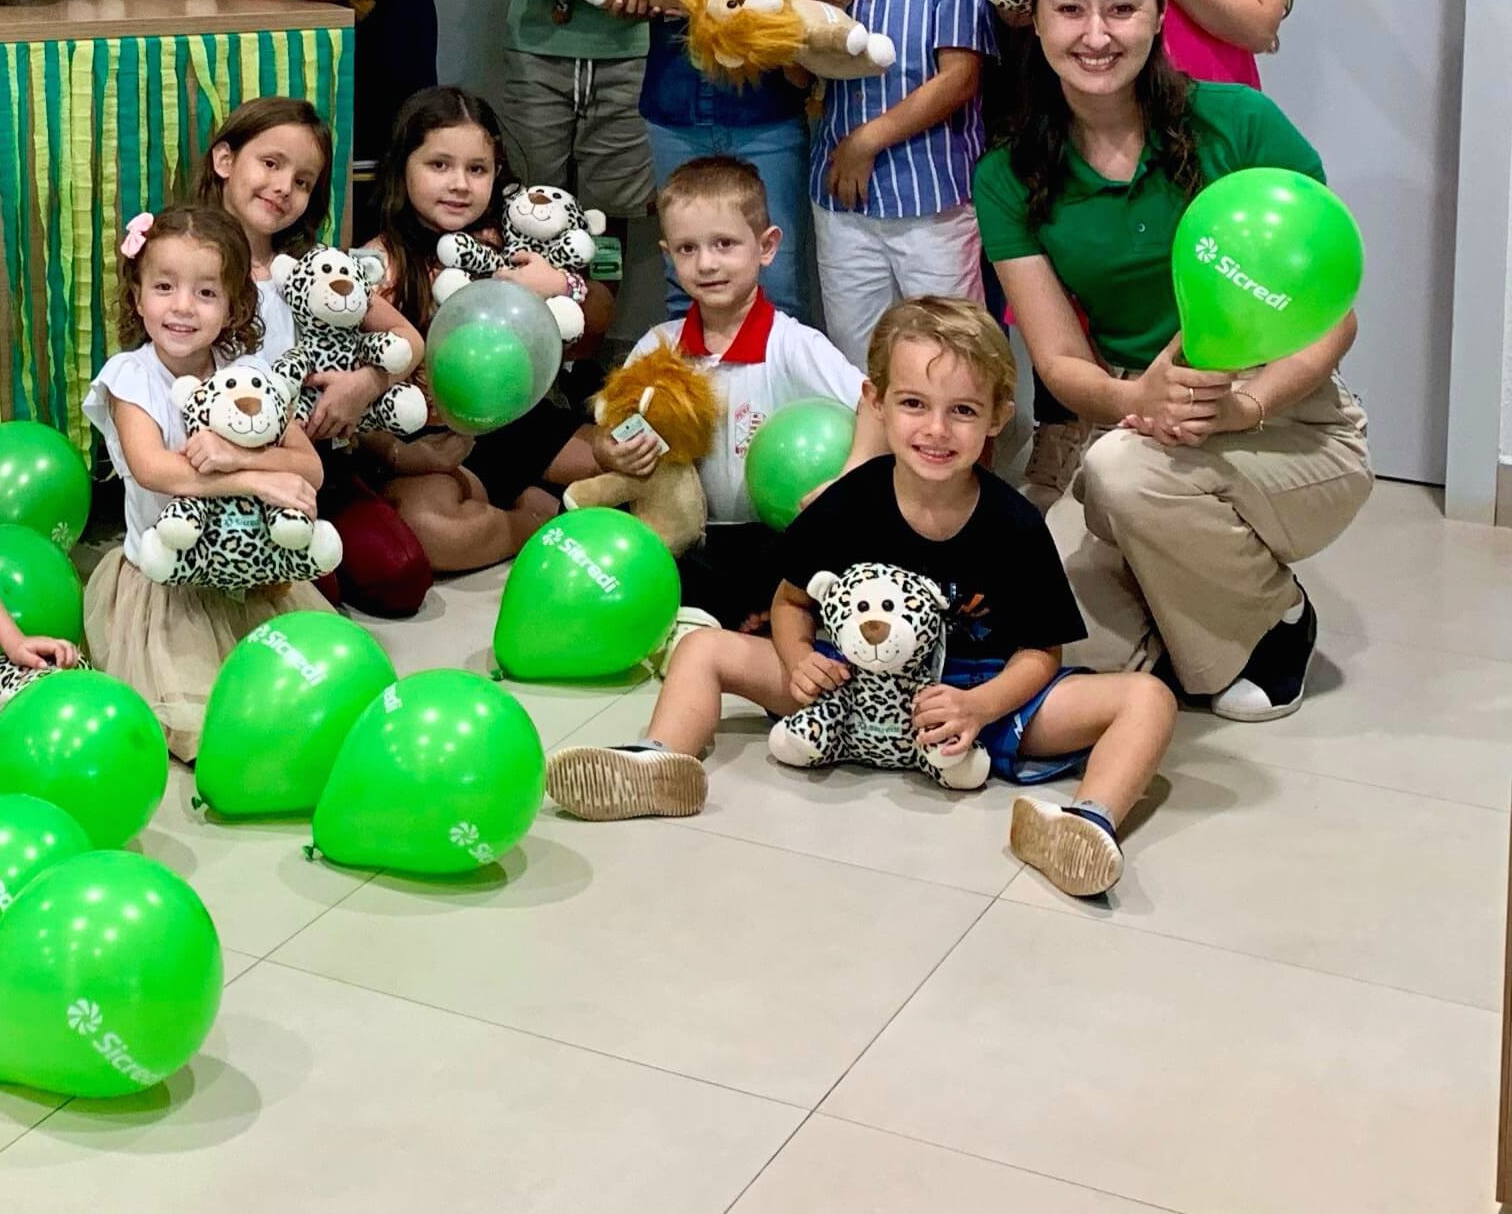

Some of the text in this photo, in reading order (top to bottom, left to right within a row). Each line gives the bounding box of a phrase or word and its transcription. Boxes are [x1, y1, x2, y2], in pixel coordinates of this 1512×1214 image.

[1214, 256, 1292, 312] Sicredi
[557, 538, 621, 594] Sicredi
[261, 631, 328, 686] Sicredi
